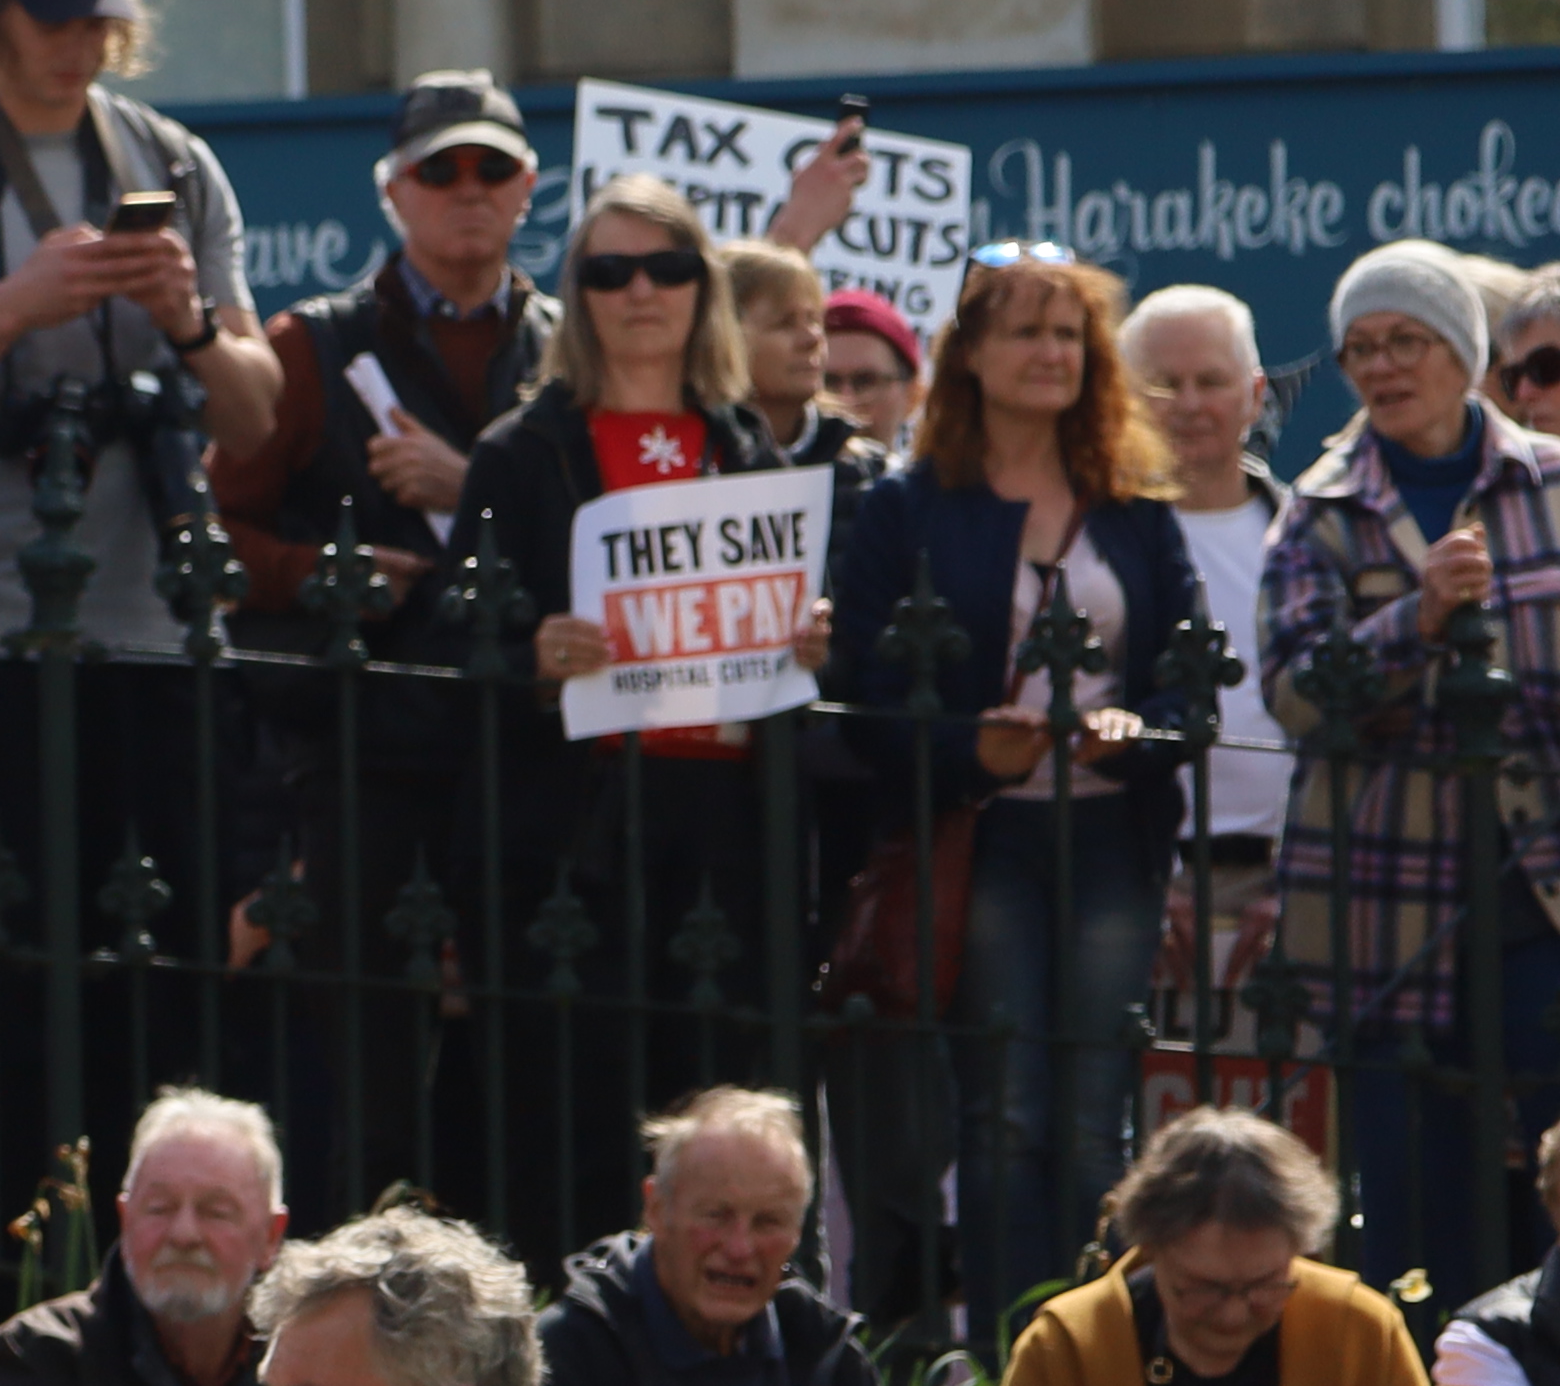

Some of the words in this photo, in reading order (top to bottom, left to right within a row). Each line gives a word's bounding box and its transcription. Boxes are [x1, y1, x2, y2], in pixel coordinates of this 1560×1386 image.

[596, 107, 751, 166] TAX
[784, 139, 956, 202] CTS
[244, 219, 386, 289] ave
[988, 138, 1348, 261] Harakeke
[835, 211, 964, 268] CUTS
[602, 521, 706, 579] THEY
[718, 511, 808, 566] SAVE
[622, 586, 713, 658] WE
[714, 576, 799, 650] PAY
[611, 667, 713, 697] HOSPITAL
[718, 659, 770, 686] CUTS
